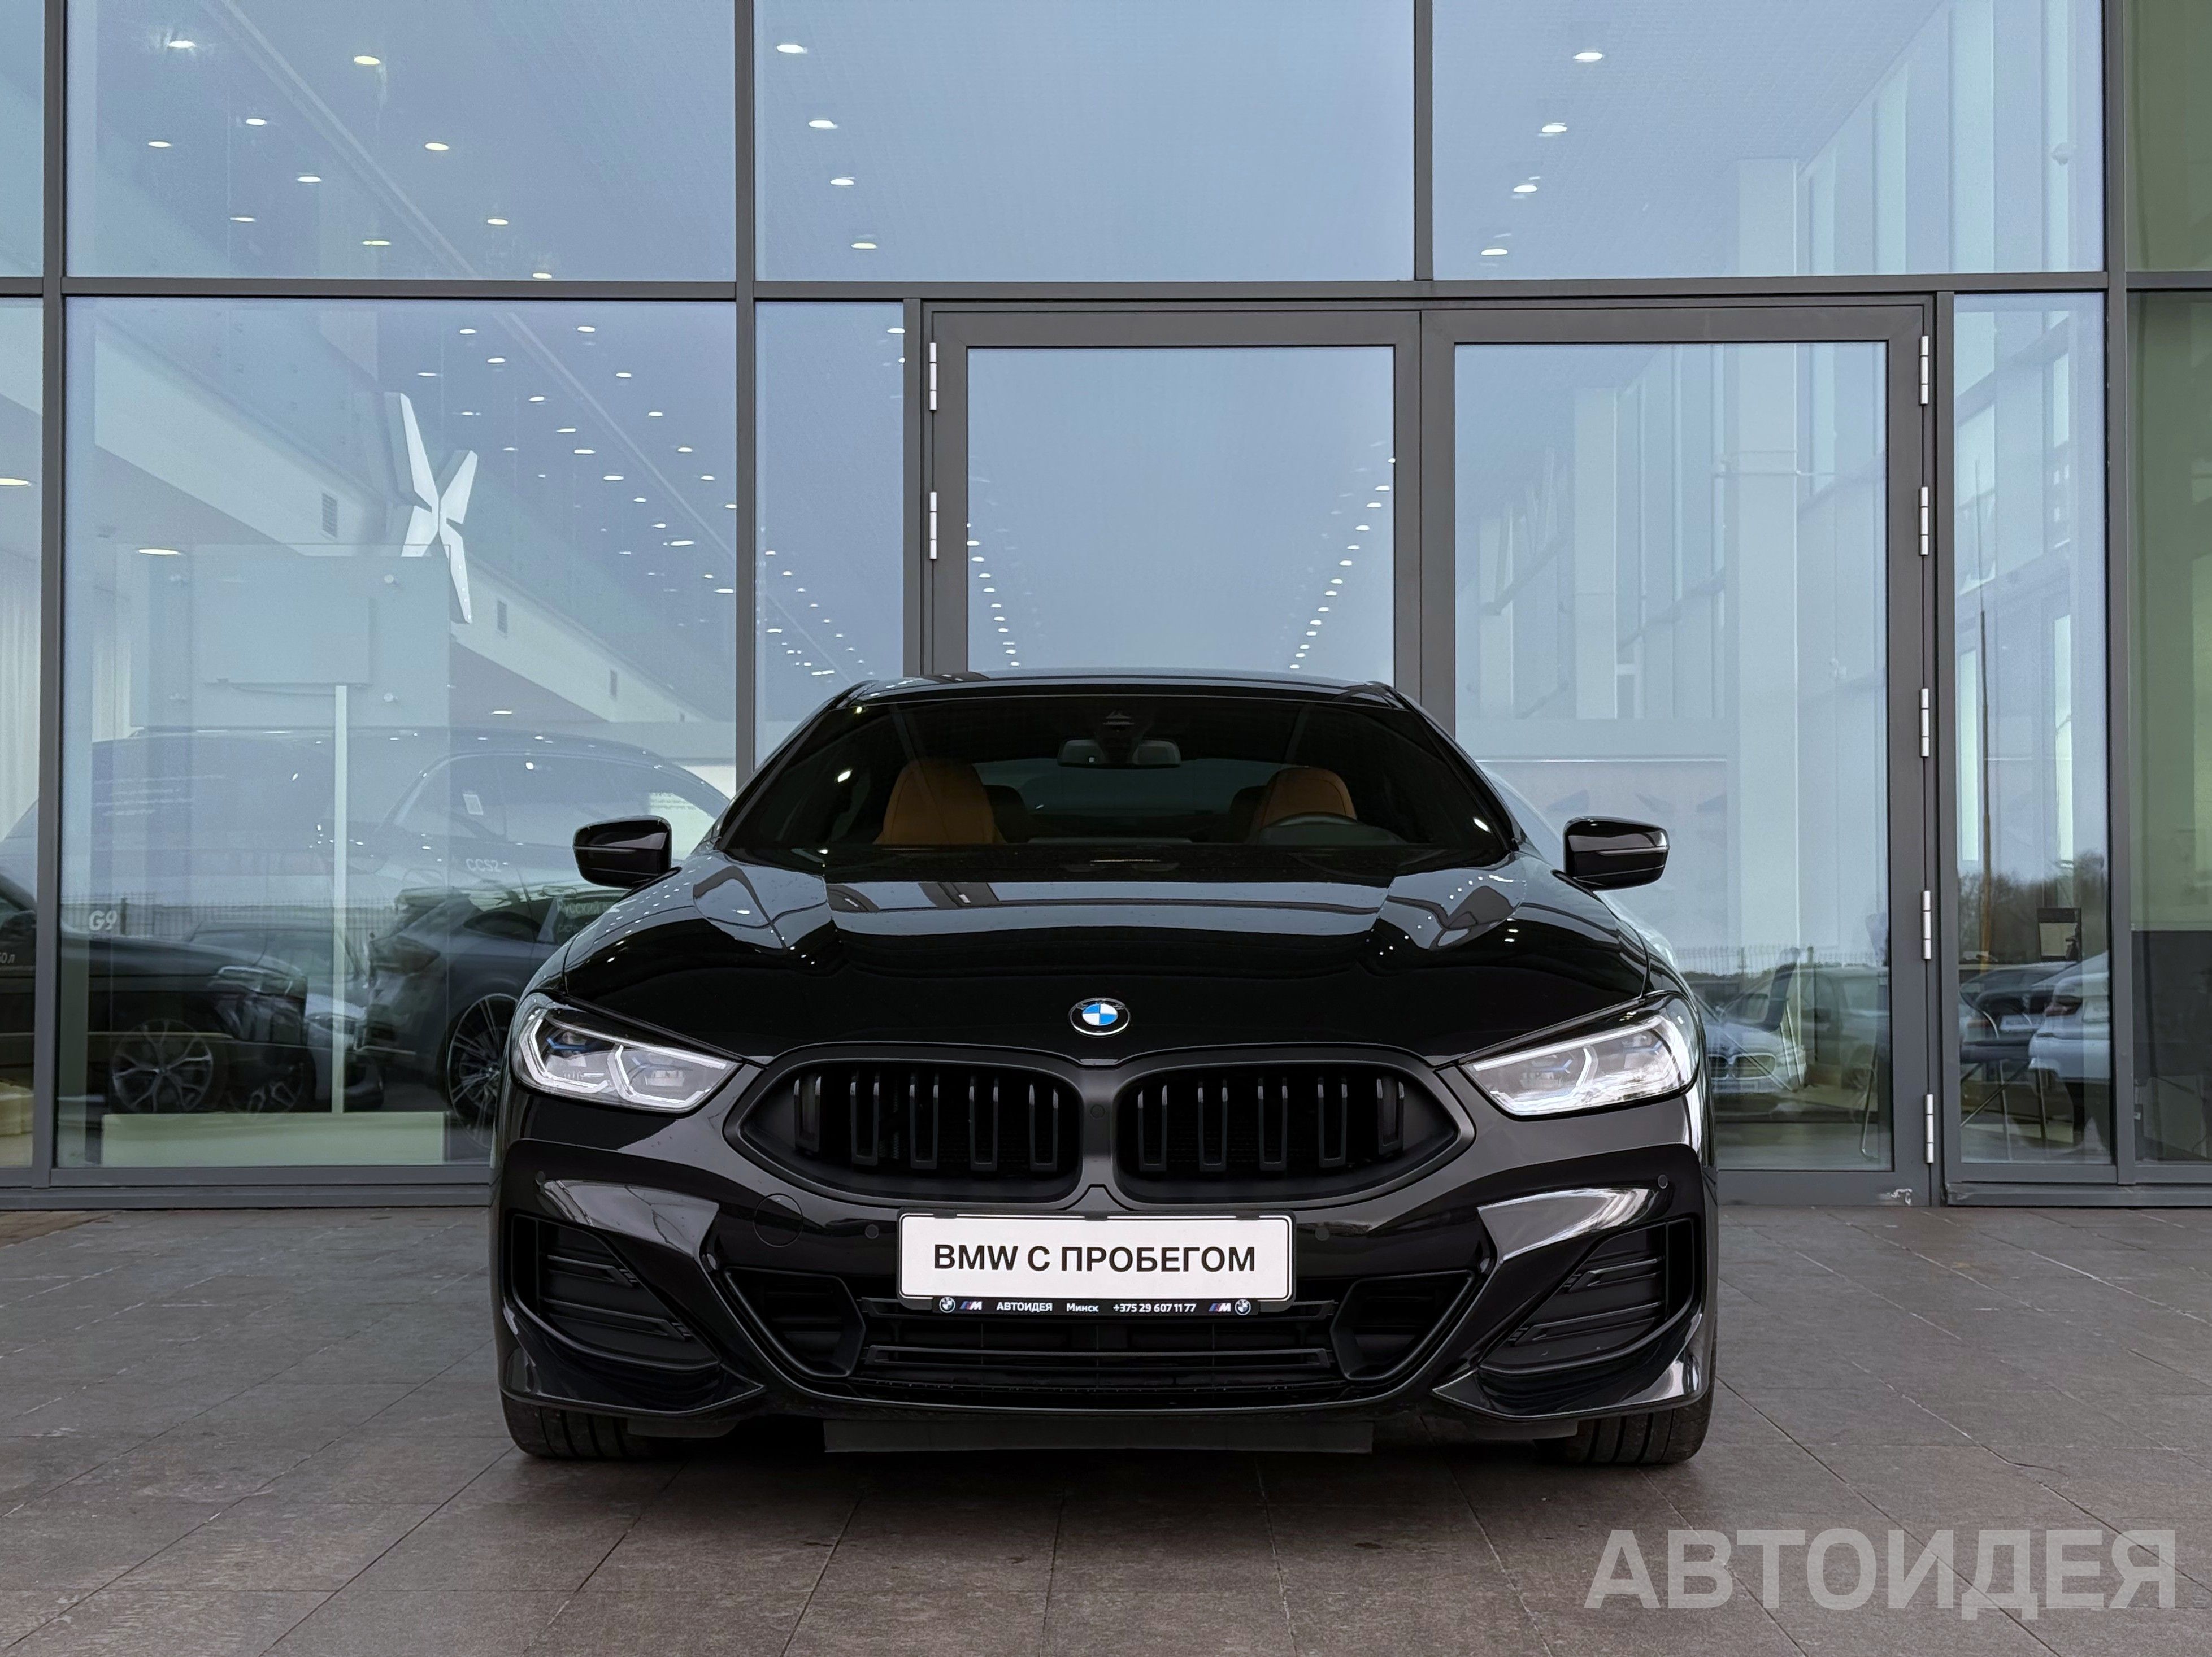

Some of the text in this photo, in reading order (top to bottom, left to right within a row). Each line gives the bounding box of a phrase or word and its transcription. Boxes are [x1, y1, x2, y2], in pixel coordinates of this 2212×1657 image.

[466, 858, 501, 872] CCS2
[89, 910, 118, 931] G9
[934, 1244, 1255, 1272] BMW С ПРОБЕГОМ
[996, 1302, 1053, 1313] АВТОИДЕЯ
[1066, 1303, 1099, 1312] Минск
[1112, 1303, 1137, 1312] +375
[1138, 1303, 1152, 1312] 29
[1153, 1303, 1173, 1312] 607
